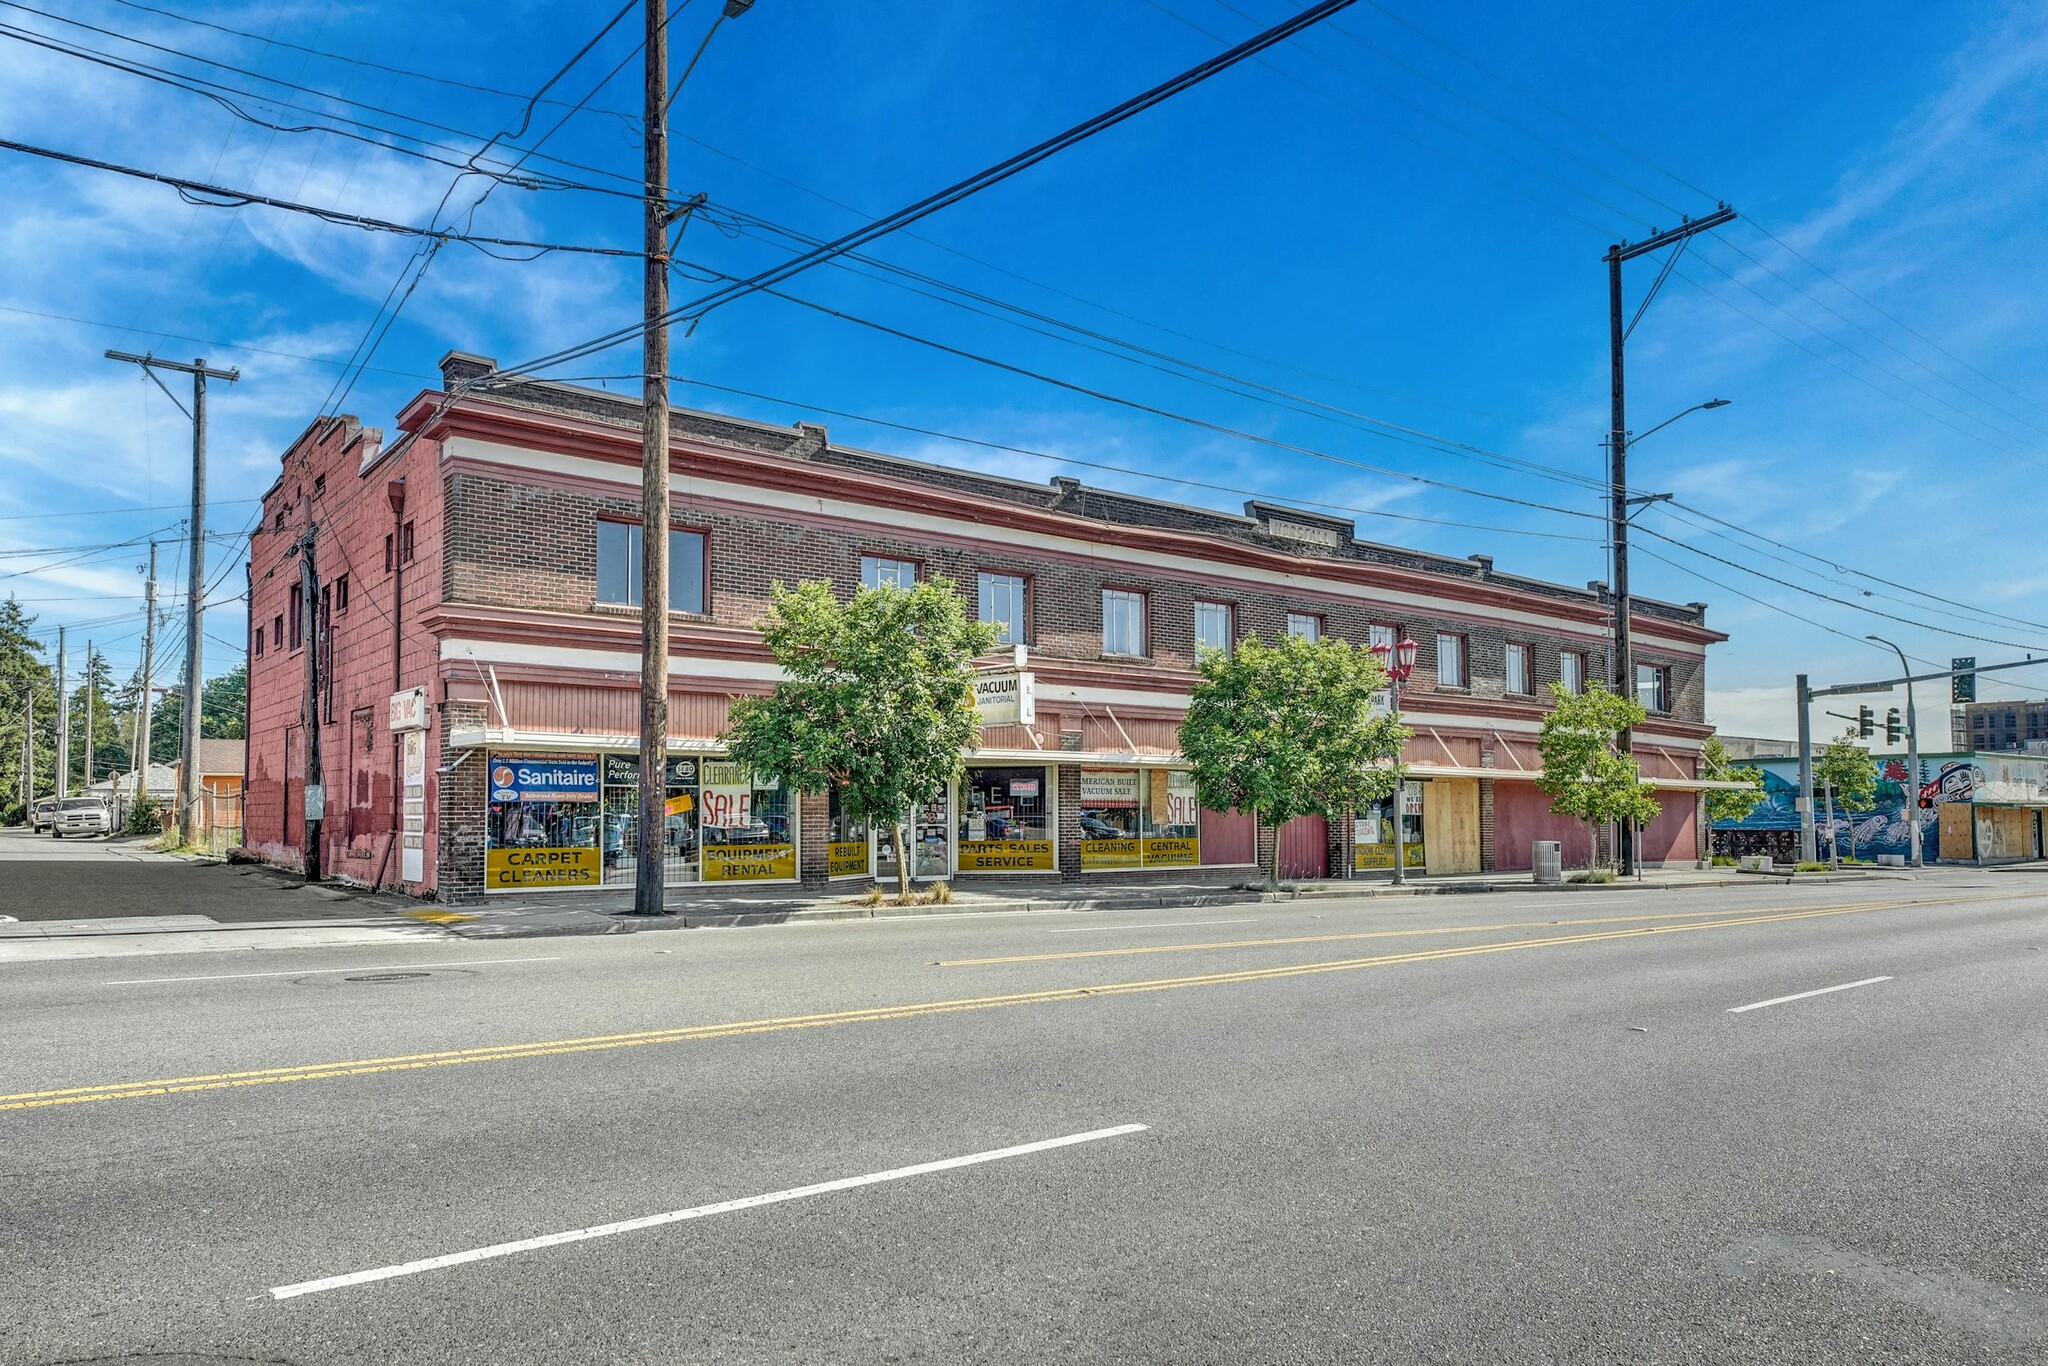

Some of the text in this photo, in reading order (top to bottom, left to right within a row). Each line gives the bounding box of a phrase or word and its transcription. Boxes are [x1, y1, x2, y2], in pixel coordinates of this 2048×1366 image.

[977, 680, 1017, 694] VACUUM
[977, 695, 1014, 705] JANITORIAL
[391, 699, 416, 721] BIG VAC
[609, 760, 631, 769] Pure
[518, 768, 595, 786] Sanitaire
[1081, 778, 1136, 786] MERICAN BUILT
[1012, 783, 1036, 791] CLOSED
[703, 790, 749, 827] SALE
[1167, 793, 1194, 824] SALE
[835, 846, 860, 857] REBUILT
[960, 844, 1049, 853] PARTS SALES
[1086, 843, 1134, 852] CLEANING
[1150, 842, 1191, 851] CENTRAL
[508, 852, 582, 865] CARPET
[707, 849, 789, 861] EQUIPMENT
[1147, 853, 1193, 863] VACUUMS
[830, 860, 865, 872] EQUIPMENT
[976, 857, 1033, 866] SERVICE
[1363, 857, 1387, 866] SUPPLIES
[499, 868, 590, 882] CLEANERS
[722, 864, 776, 875] RENTAL
